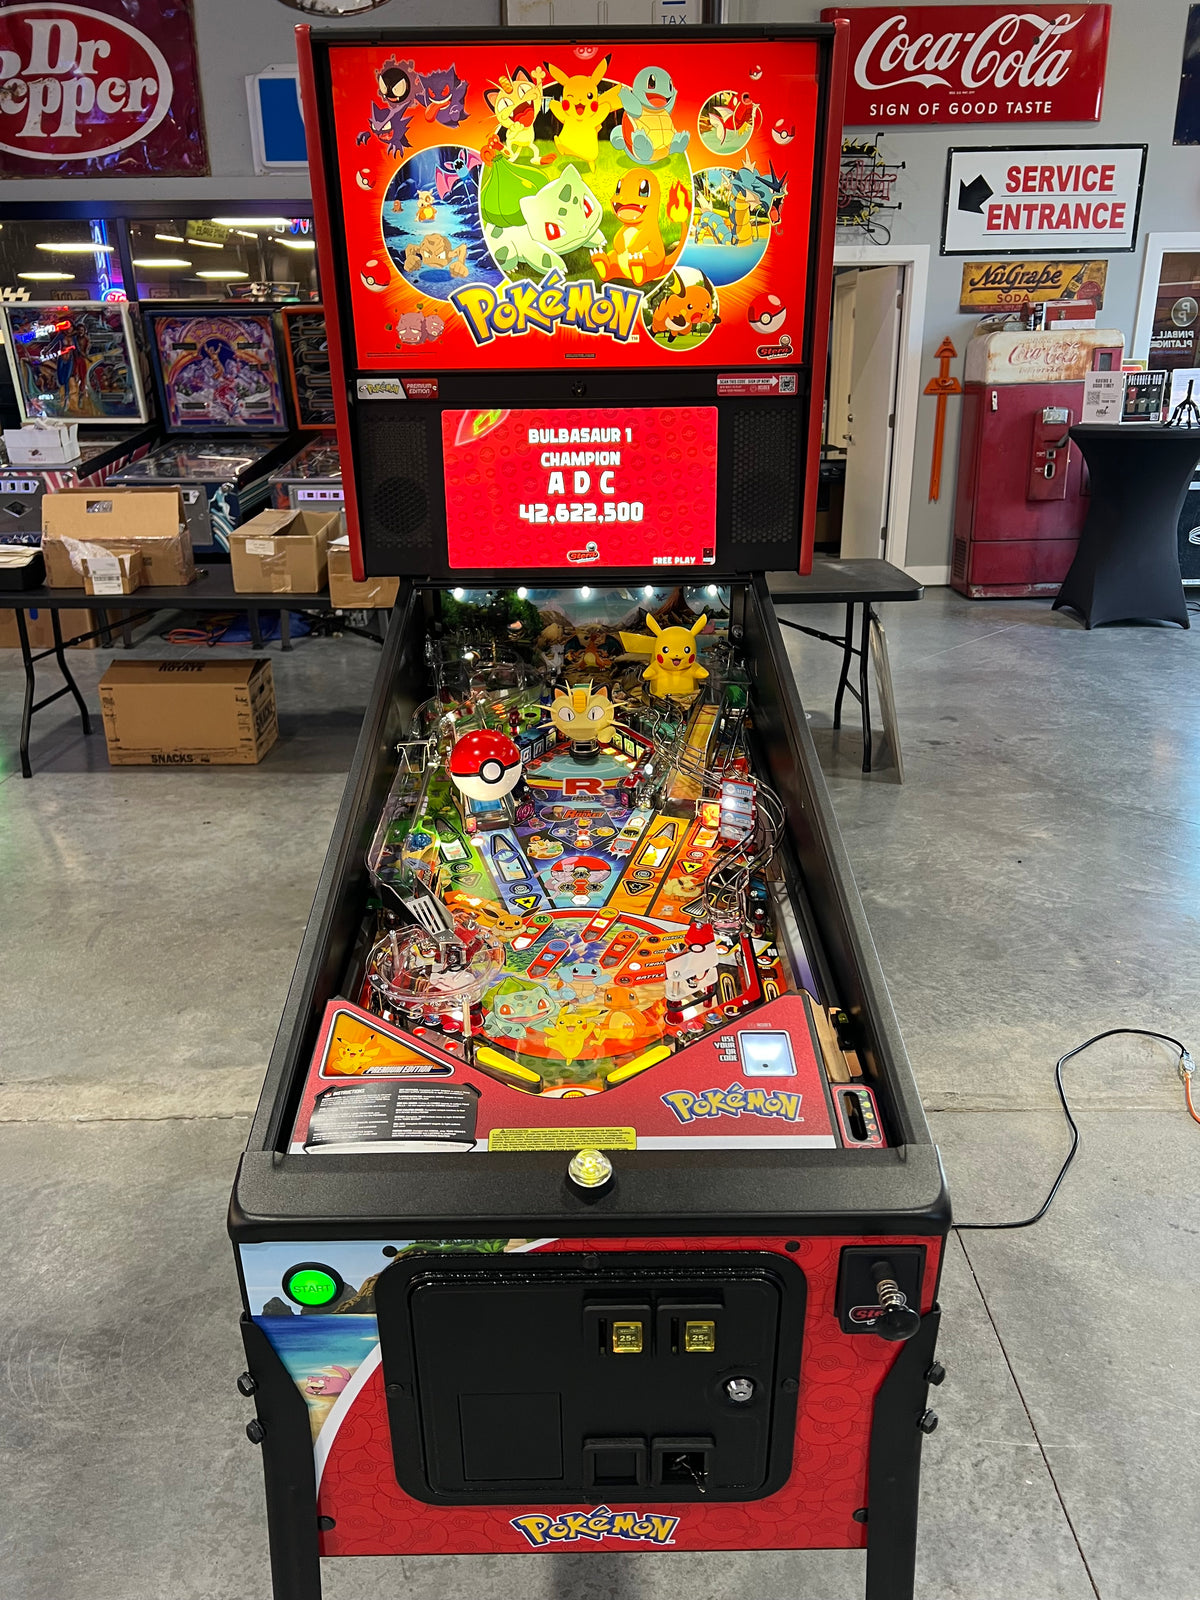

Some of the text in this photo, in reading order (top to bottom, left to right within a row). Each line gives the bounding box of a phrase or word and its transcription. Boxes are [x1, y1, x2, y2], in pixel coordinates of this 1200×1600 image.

[661, 15, 687, 25] TAX
[21, 18, 111, 75] Dr
[853, 13, 1086, 90] Coca-Cola
[870, 101, 1052, 116] SIGN OF GOOD TASTE
[1005, 165, 1116, 193] SERVICE
[986, 202, 1126, 230] ENTRANCE
[969, 263, 1063, 293] NuGrape
[447, 267, 644, 347] Pokémon
[997, 294, 1031, 304] SODA
[367, 381, 400, 395] Pokémon
[528, 427, 632, 444] BULBASAUR 1
[540, 451, 621, 467] CHAMPION
[547, 471, 615, 495] A D C
[519, 502, 644, 525] 42,622,500
[653, 557, 672, 565] FREE
[151, 754, 194, 763] SNACKS
[563, 777, 605, 796] R
[635, 973, 665, 981] BATTLE
[366, 1065, 434, 1074] PREMIUM EDITION
[660, 1081, 803, 1124] Pokémon
[293, 1285, 331, 1293] START
[855, 1310, 885, 1320] Ste
[508, 1504, 681, 1548] Pokémon
